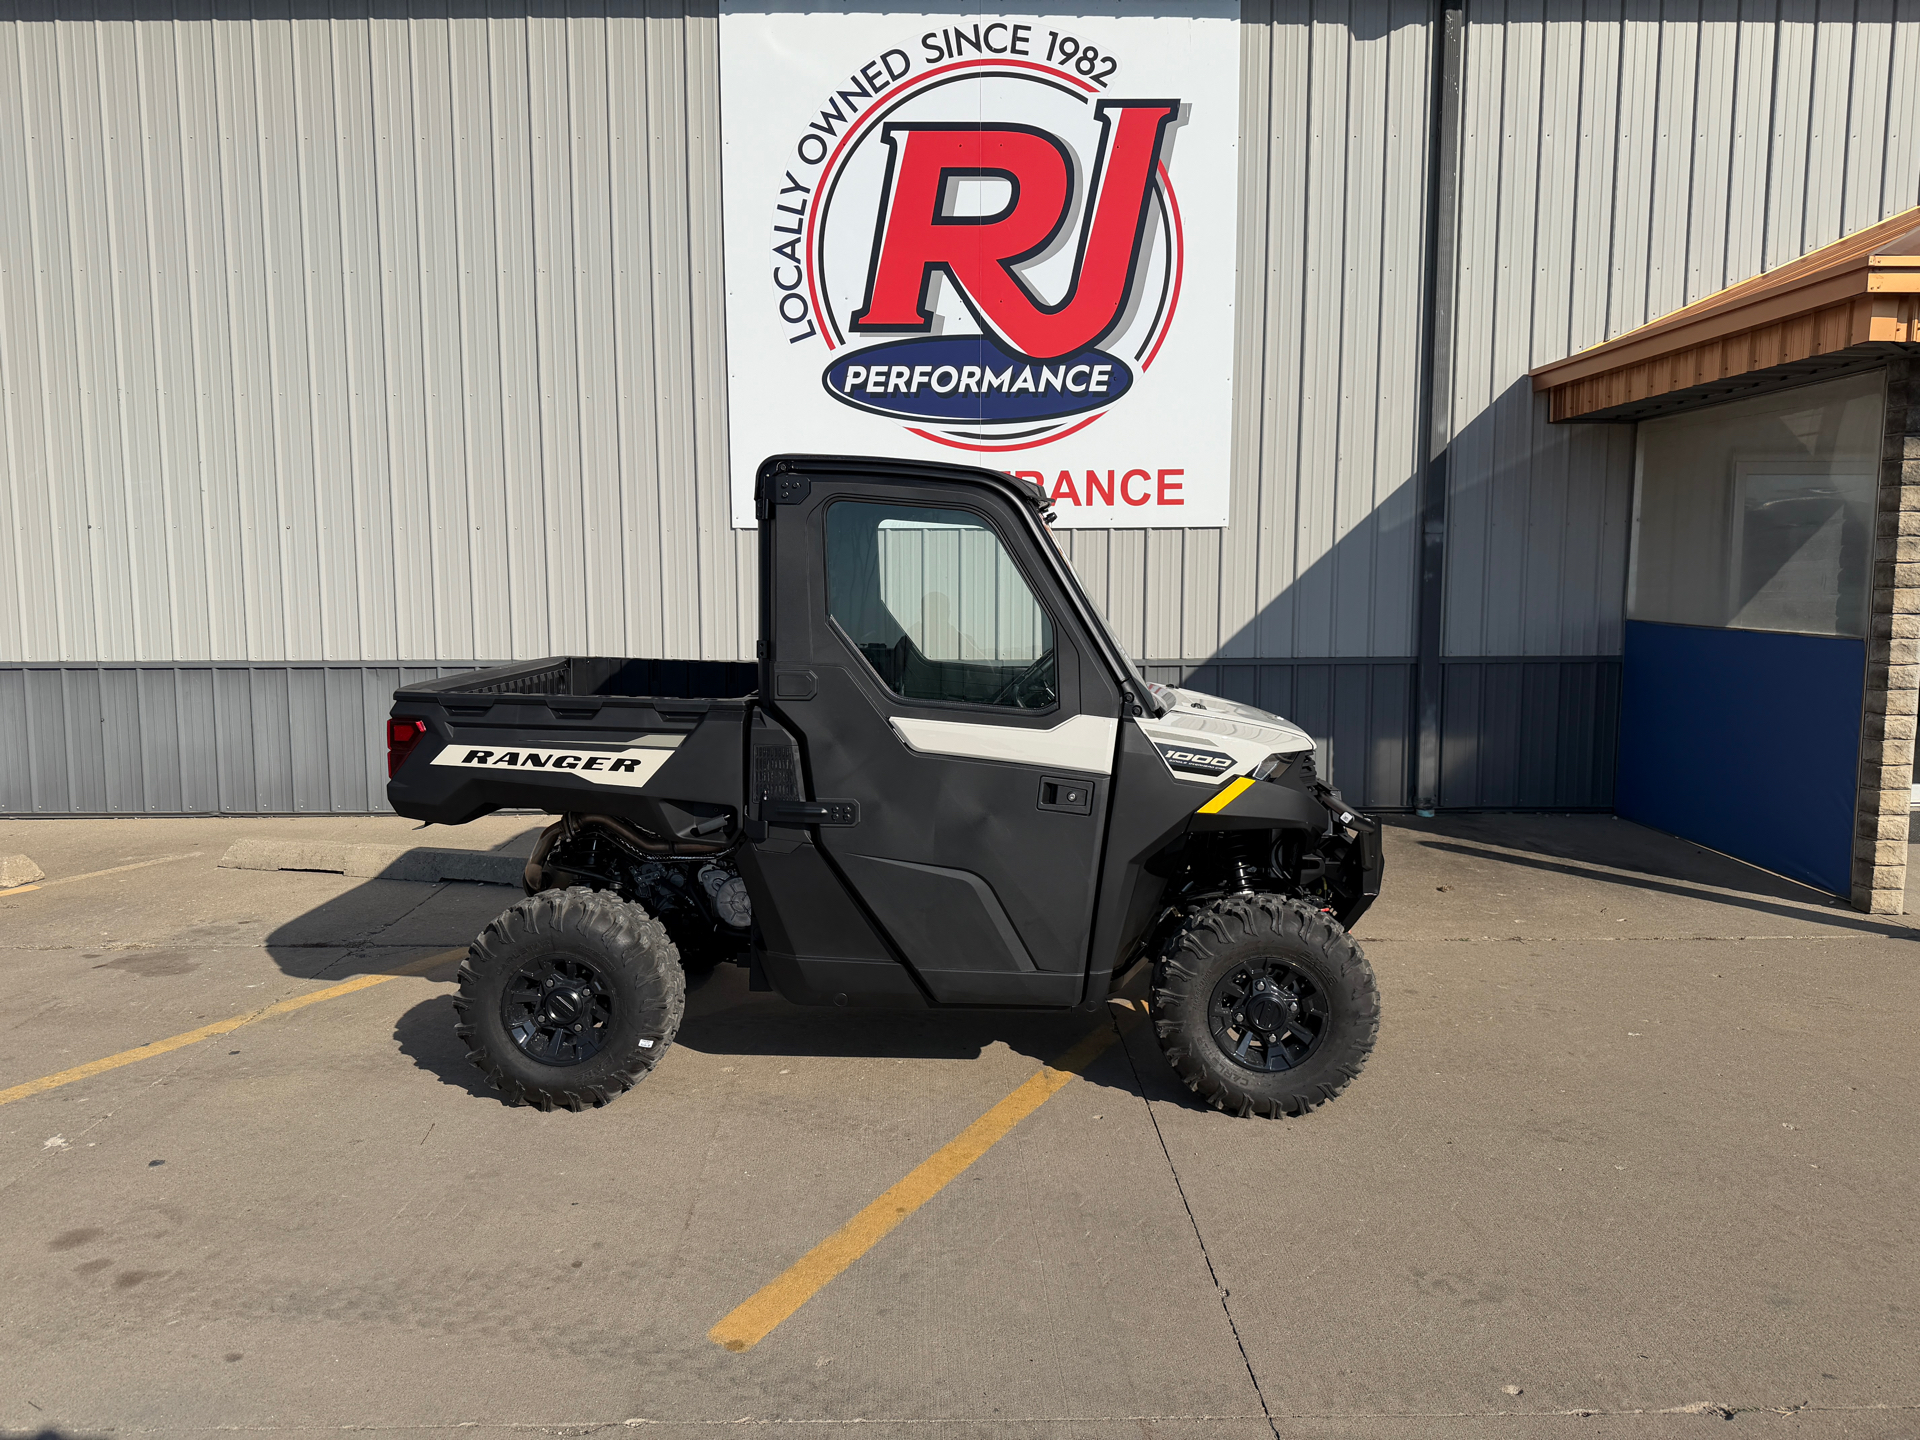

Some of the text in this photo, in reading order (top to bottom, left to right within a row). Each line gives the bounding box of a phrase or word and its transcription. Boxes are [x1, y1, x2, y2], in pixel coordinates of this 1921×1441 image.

[773, 22, 1118, 344] LOCALLY OWNED SINCE 1982
[849, 98, 1181, 360] RJ
[843, 364, 1112, 395] PERFORMANCE
[461, 749, 642, 773] RANGER
[1165, 750, 1232, 767] 1000
